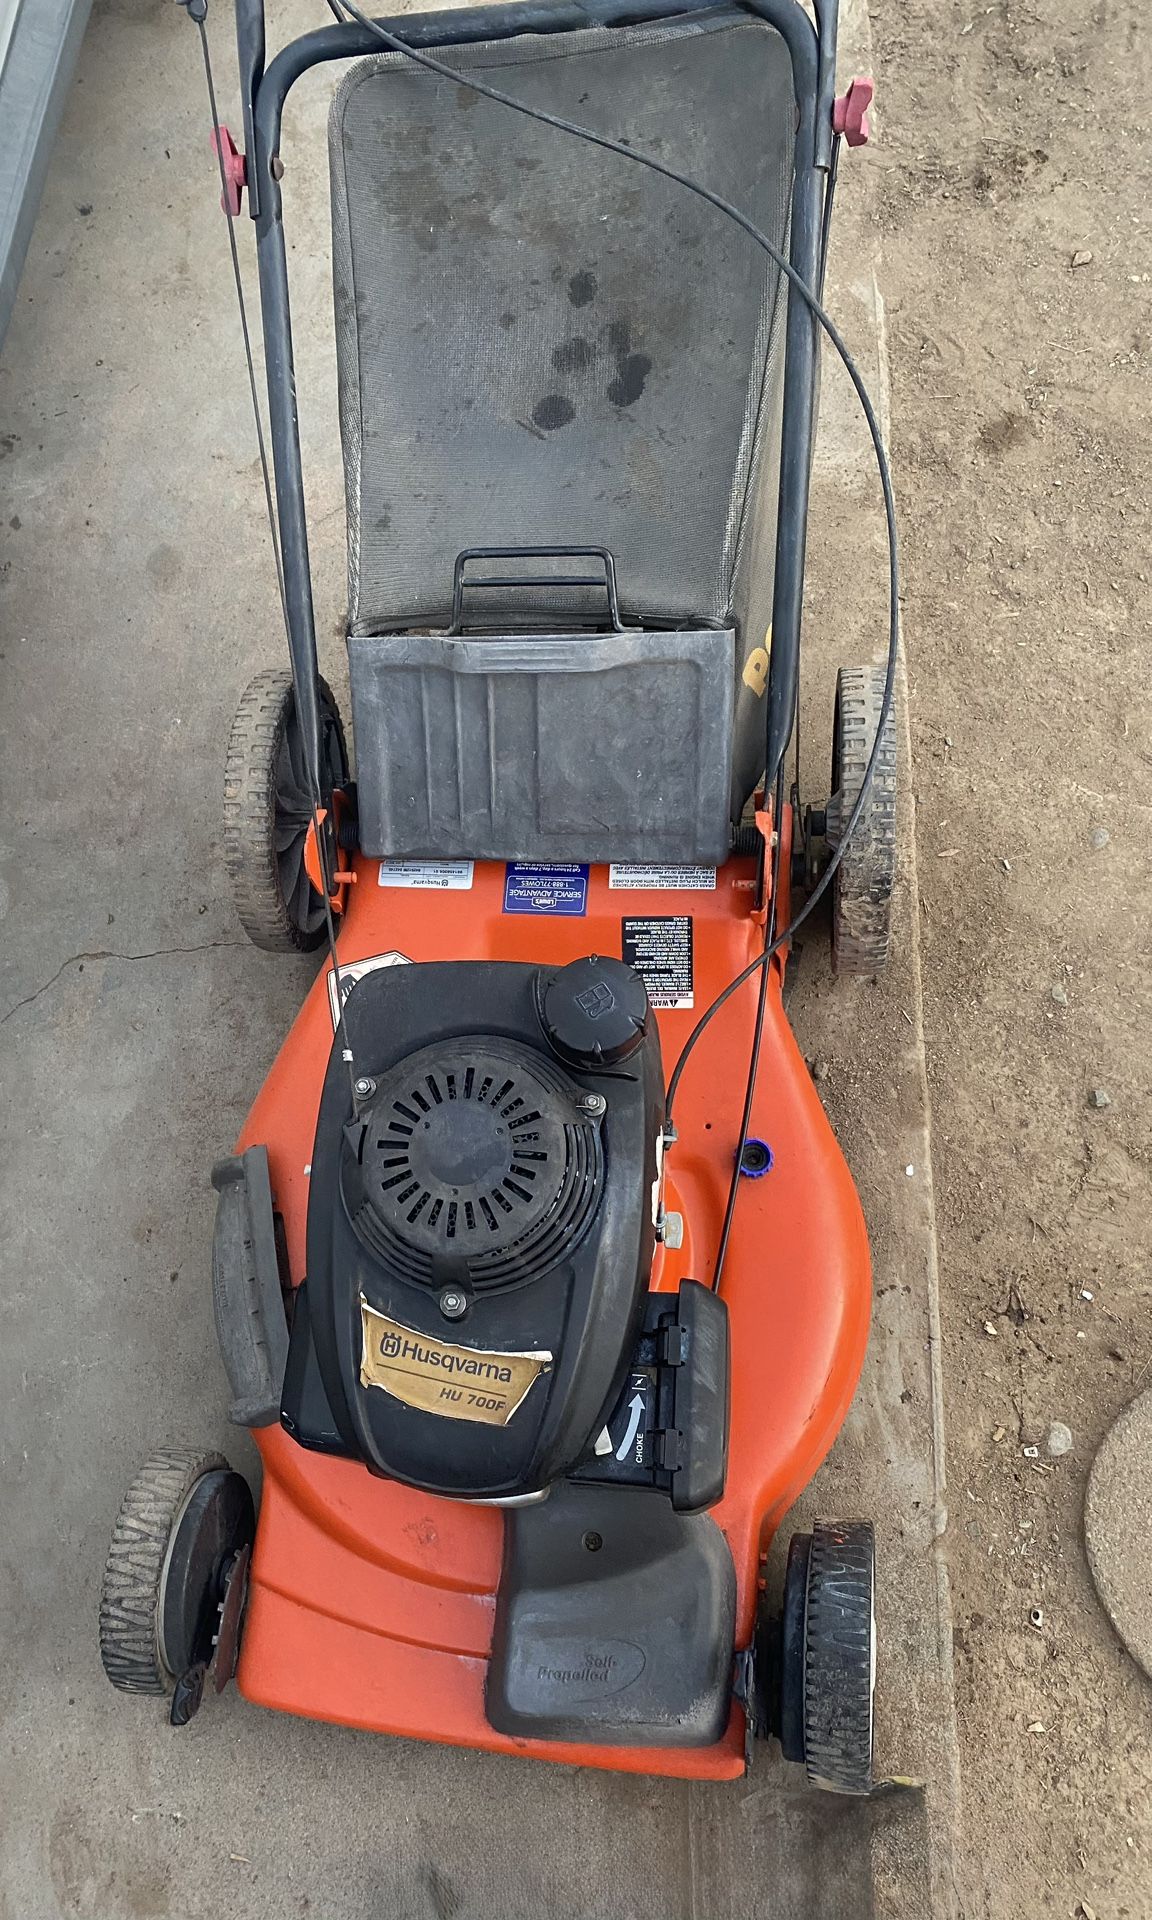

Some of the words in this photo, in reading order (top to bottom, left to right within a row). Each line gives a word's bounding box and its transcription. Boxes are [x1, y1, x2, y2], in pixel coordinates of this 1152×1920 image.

[402, 1339, 512, 1383] Husqvarna
[440, 1386, 463, 1402] HU
[468, 1392, 506, 1412] 700F
[636, 1432, 644, 1464] CHOKE
[537, 1666, 610, 1683] Propelled
